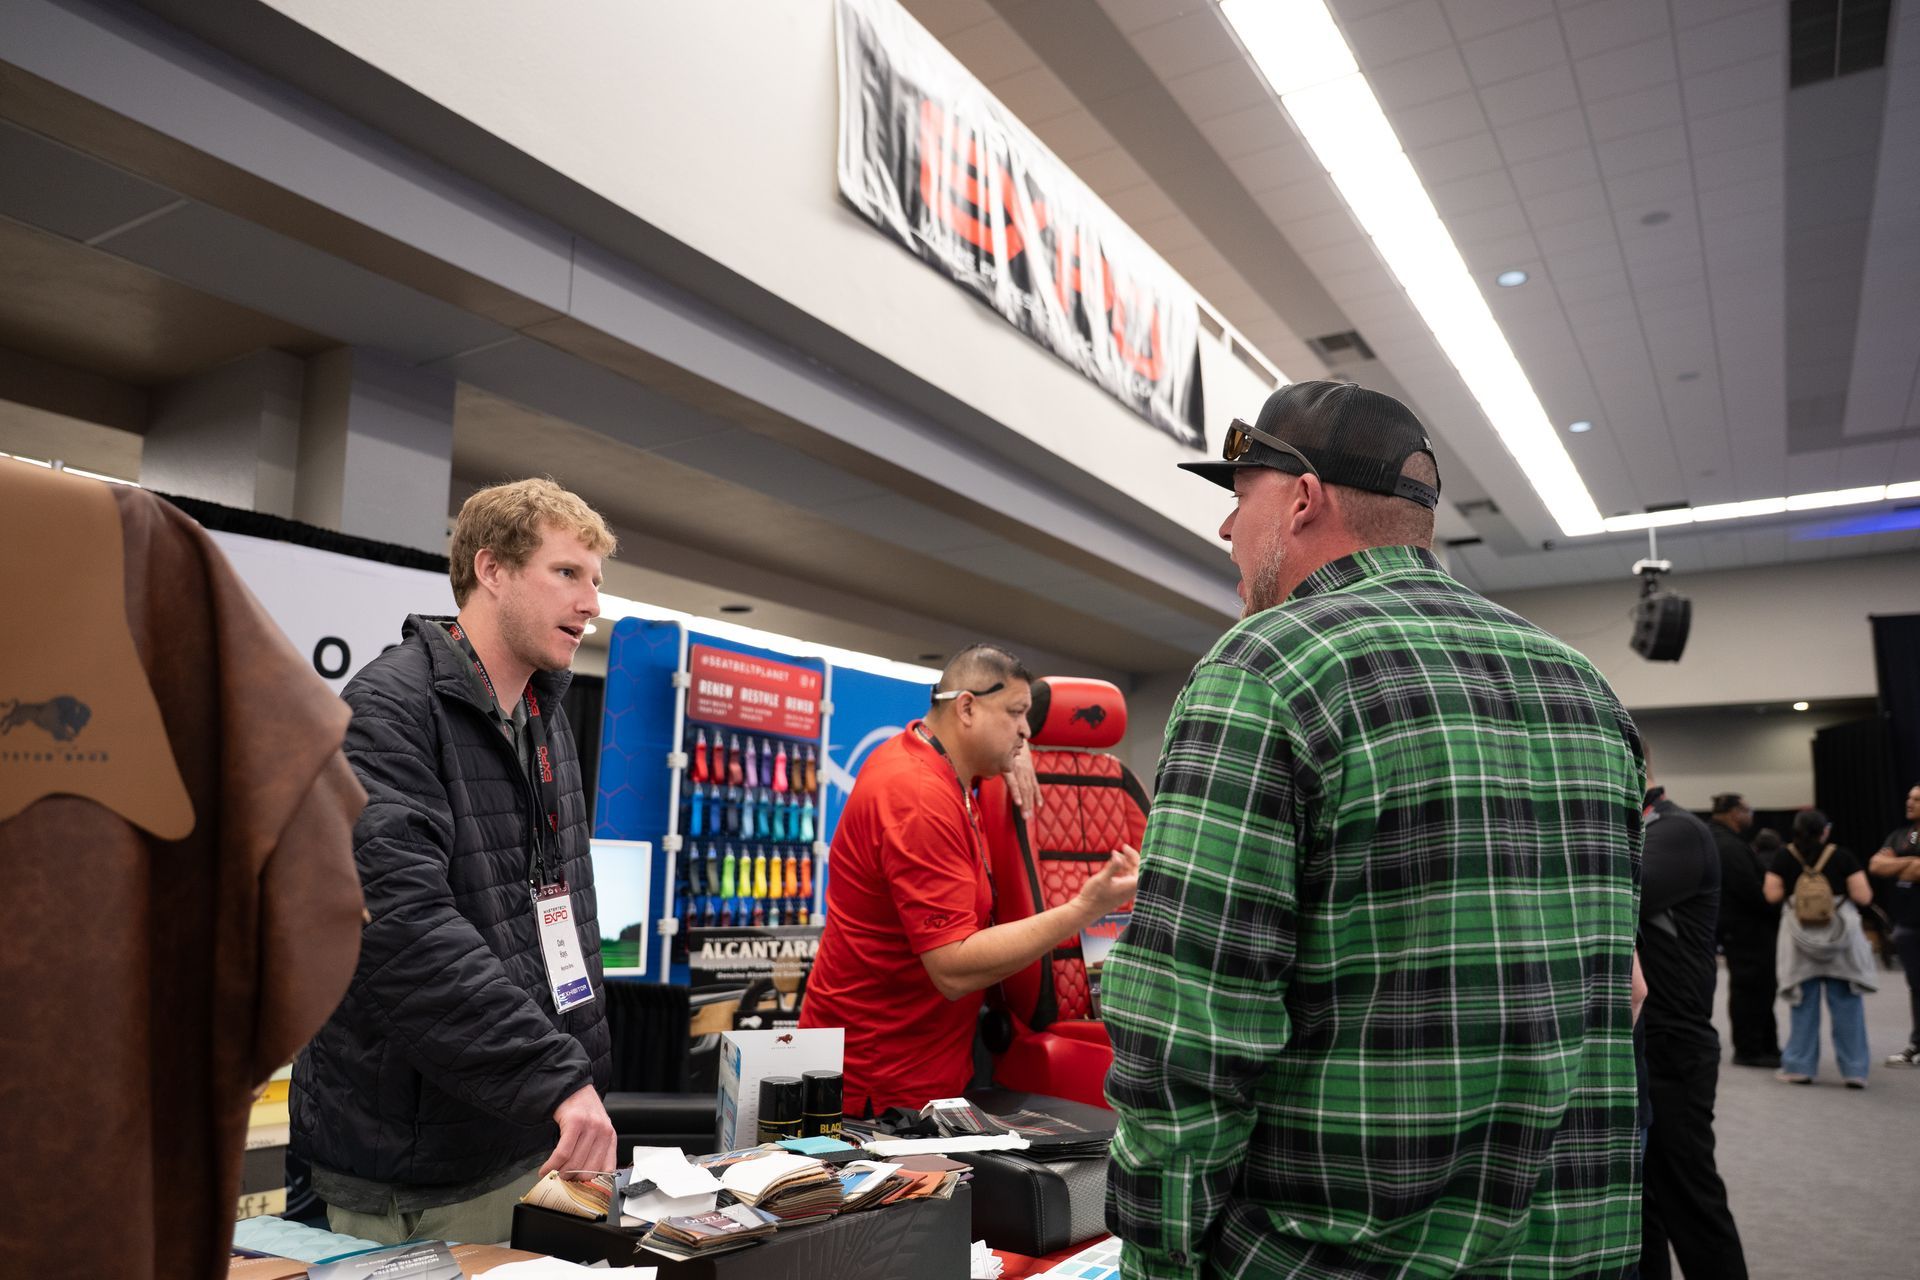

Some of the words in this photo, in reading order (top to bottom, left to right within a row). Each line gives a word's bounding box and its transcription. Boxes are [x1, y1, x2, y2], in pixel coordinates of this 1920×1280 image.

[540, 745, 553, 783] EXPO
[543, 909, 568, 925] EXPO
[701, 940, 820, 960] ALCANTARA
